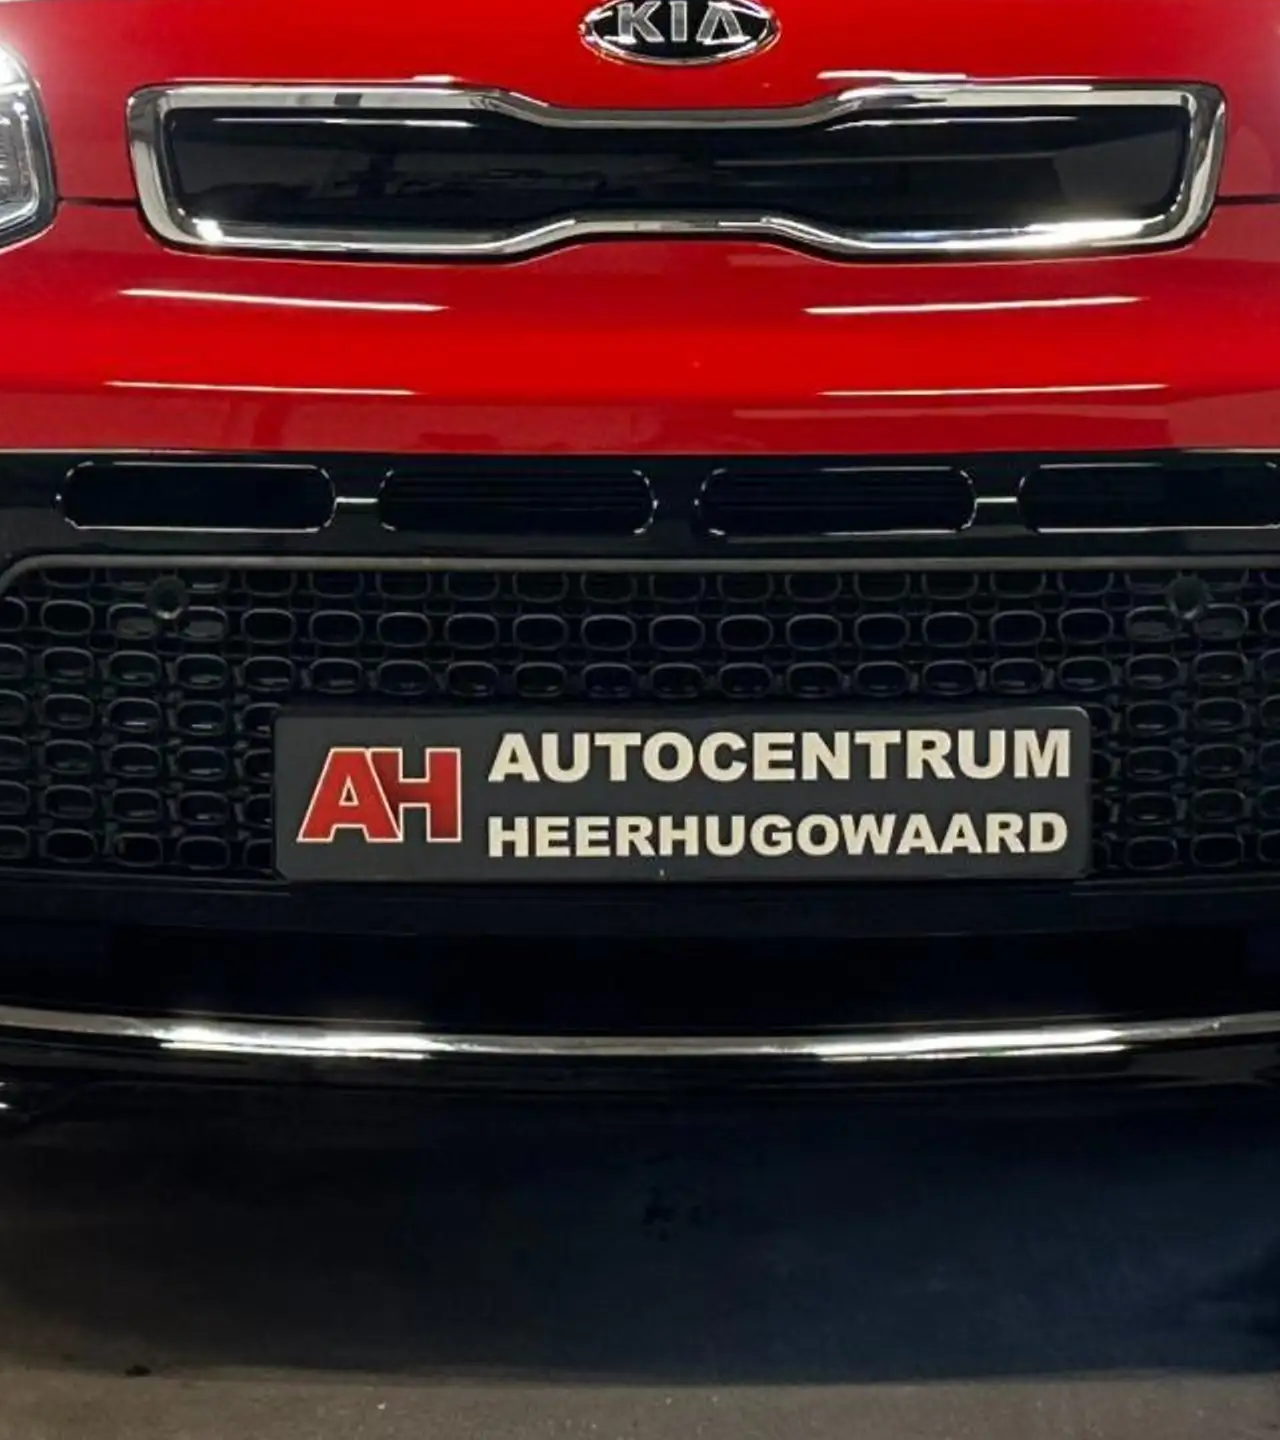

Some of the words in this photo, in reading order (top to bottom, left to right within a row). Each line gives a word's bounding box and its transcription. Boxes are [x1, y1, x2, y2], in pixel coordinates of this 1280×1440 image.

[614, 0, 747, 45] KIA
[488, 730, 1070, 782] AUTOCENTRUM
[297, 748, 461, 842] AH
[488, 813, 1068, 857] HEERHUGOWAARD
